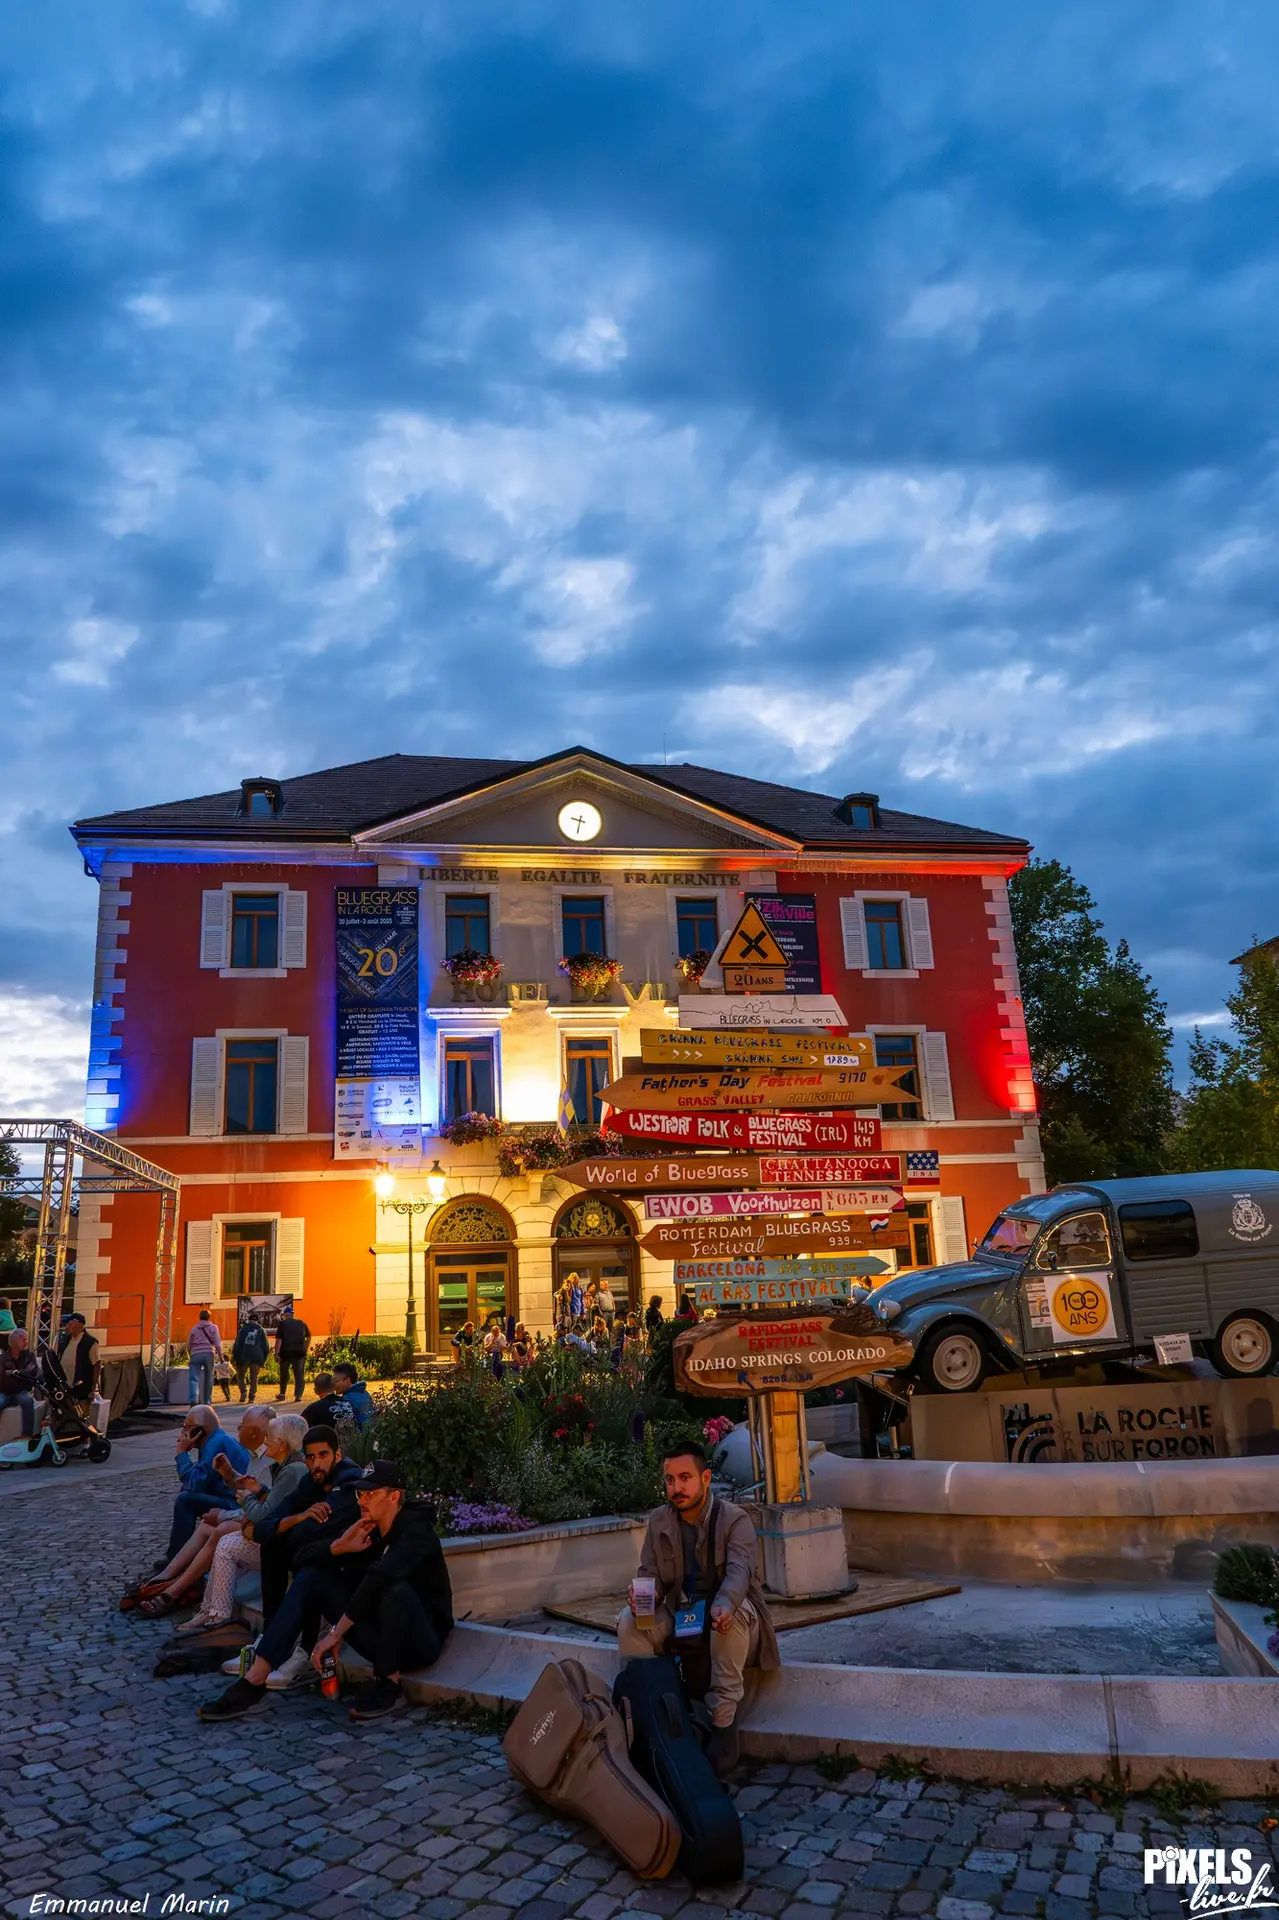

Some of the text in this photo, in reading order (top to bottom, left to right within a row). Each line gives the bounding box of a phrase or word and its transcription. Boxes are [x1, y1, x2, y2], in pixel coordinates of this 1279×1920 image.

[418, 867, 741, 886] LIBERTE EGALITE FRATERNITE
[337, 891, 417, 905] BLUEGRASS
[338, 906, 392, 914] IN LA ROCHE
[762, 902, 783, 913] Zik
[784, 908, 815, 919] Ville
[733, 974, 774, 986] 20 ANS
[720, 1015, 761, 1024] BLUEGRASS
[796, 1039, 853, 1051] FESTIVAL
[640, 1072, 867, 1090] Father's Day Festival 9170
[678, 1095, 718, 1106] GRASS
[722, 1094, 765, 1105] VALLEY
[629, 1113, 812, 1138] WESTPORT FOLK & BLUEGRASS
[815, 1123, 848, 1143] (IRL)
[853, 1121, 875, 1135] 1419
[749, 1131, 807, 1146] FESTIVAL
[854, 1135, 871, 1147] KM
[586, 1163, 749, 1183] World of Bluegrass
[766, 1158, 892, 1171] CHATTANOOGA
[773, 1169, 863, 1182] TENNESSEE
[648, 1194, 821, 1217] EWOB Voorthuizen
[659, 1219, 851, 1241] ROTTERDAM BLUEGRASS
[691, 1236, 765, 1258] Festival
[829, 1236, 850, 1246] 939
[677, 1262, 767, 1279] BARCELONA
[699, 1286, 717, 1302] AL
[757, 1280, 839, 1299] FESTIVAL
[1061, 1290, 1099, 1312] 100
[1070, 1311, 1098, 1326] ANS
[738, 1321, 823, 1338] RAPIDGRASS
[749, 1335, 818, 1351] FESTIVAL
[688, 1347, 886, 1372] IDAHO SPRINGS COLORADO
[1077, 1405, 1212, 1435] LA ROCHE
[1082, 1435, 1216, 1462] SUR FORON
[683, 1613, 696, 1624] 20
[530, 1709, 557, 1746] Taylor
